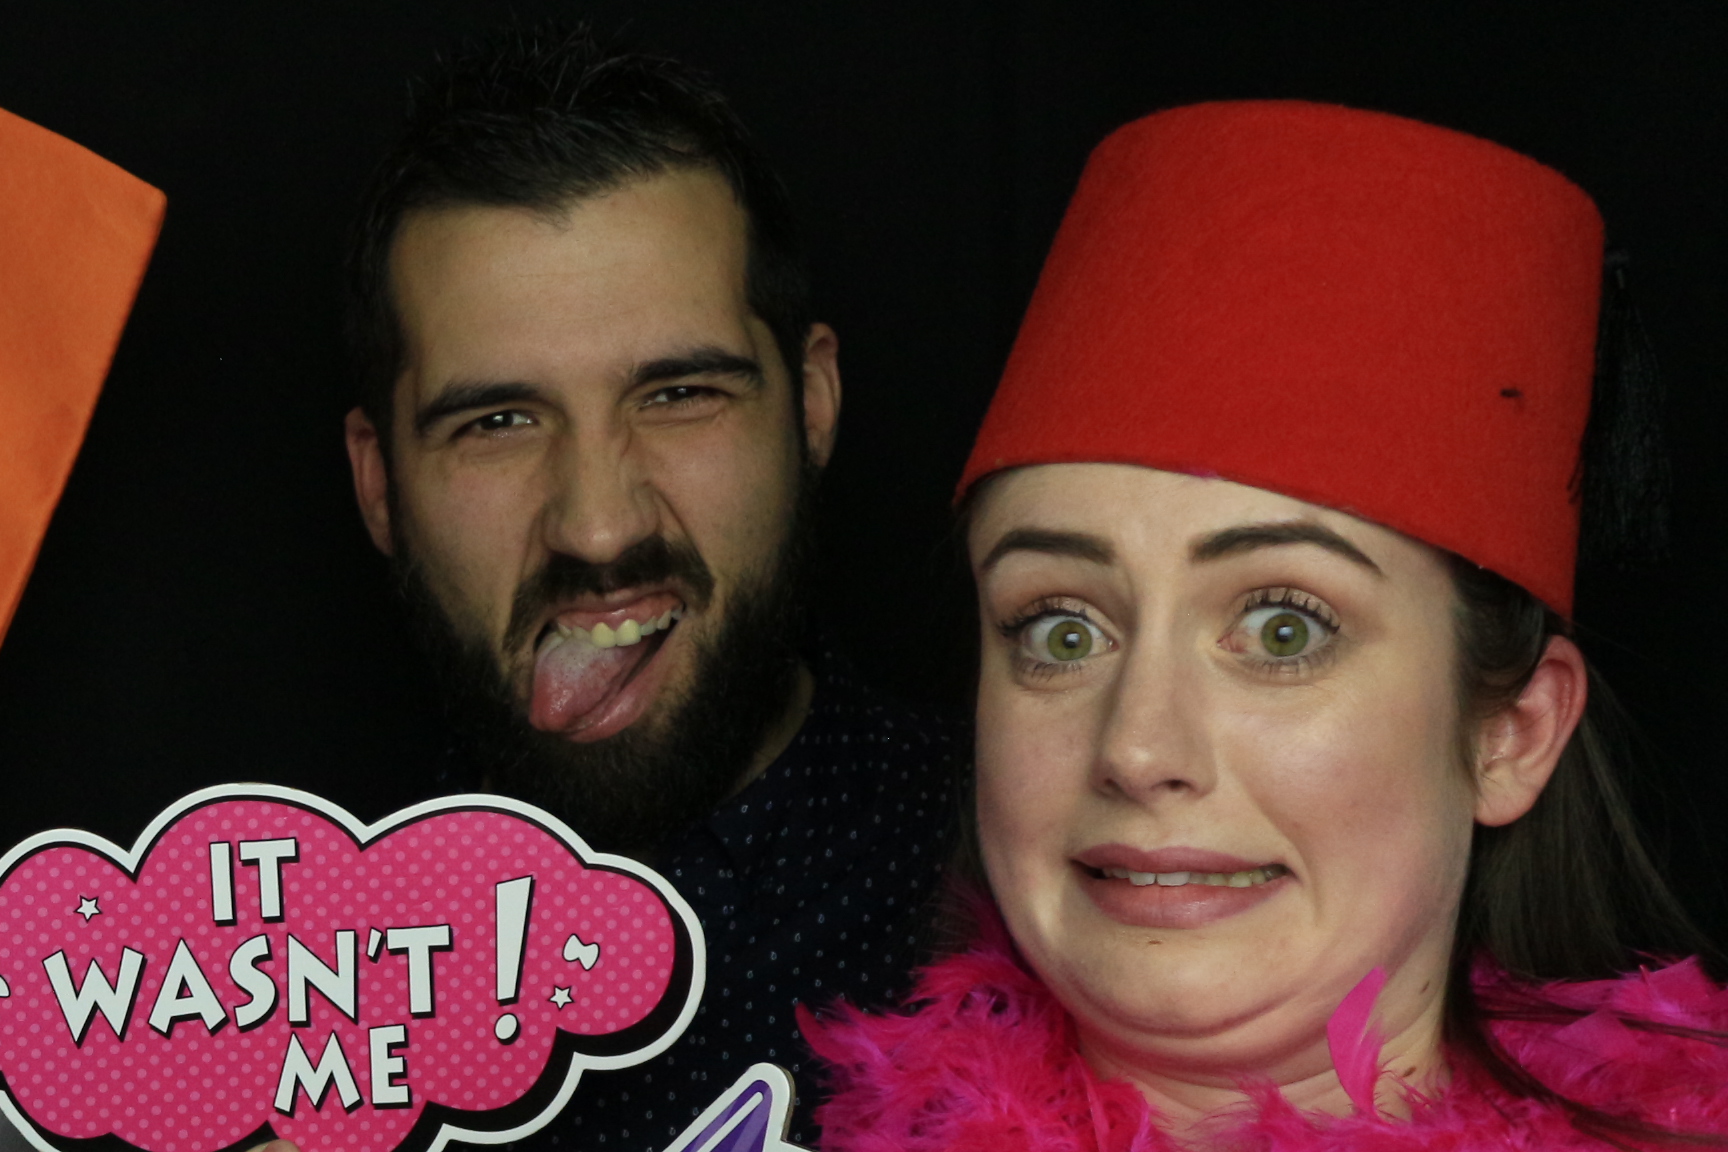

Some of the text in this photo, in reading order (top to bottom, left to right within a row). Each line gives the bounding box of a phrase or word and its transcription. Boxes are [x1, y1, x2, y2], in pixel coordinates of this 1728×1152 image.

[210, 837, 297, 922] IT
[42, 924, 451, 1043] WASN'T
[274, 1025, 410, 1112] ME
